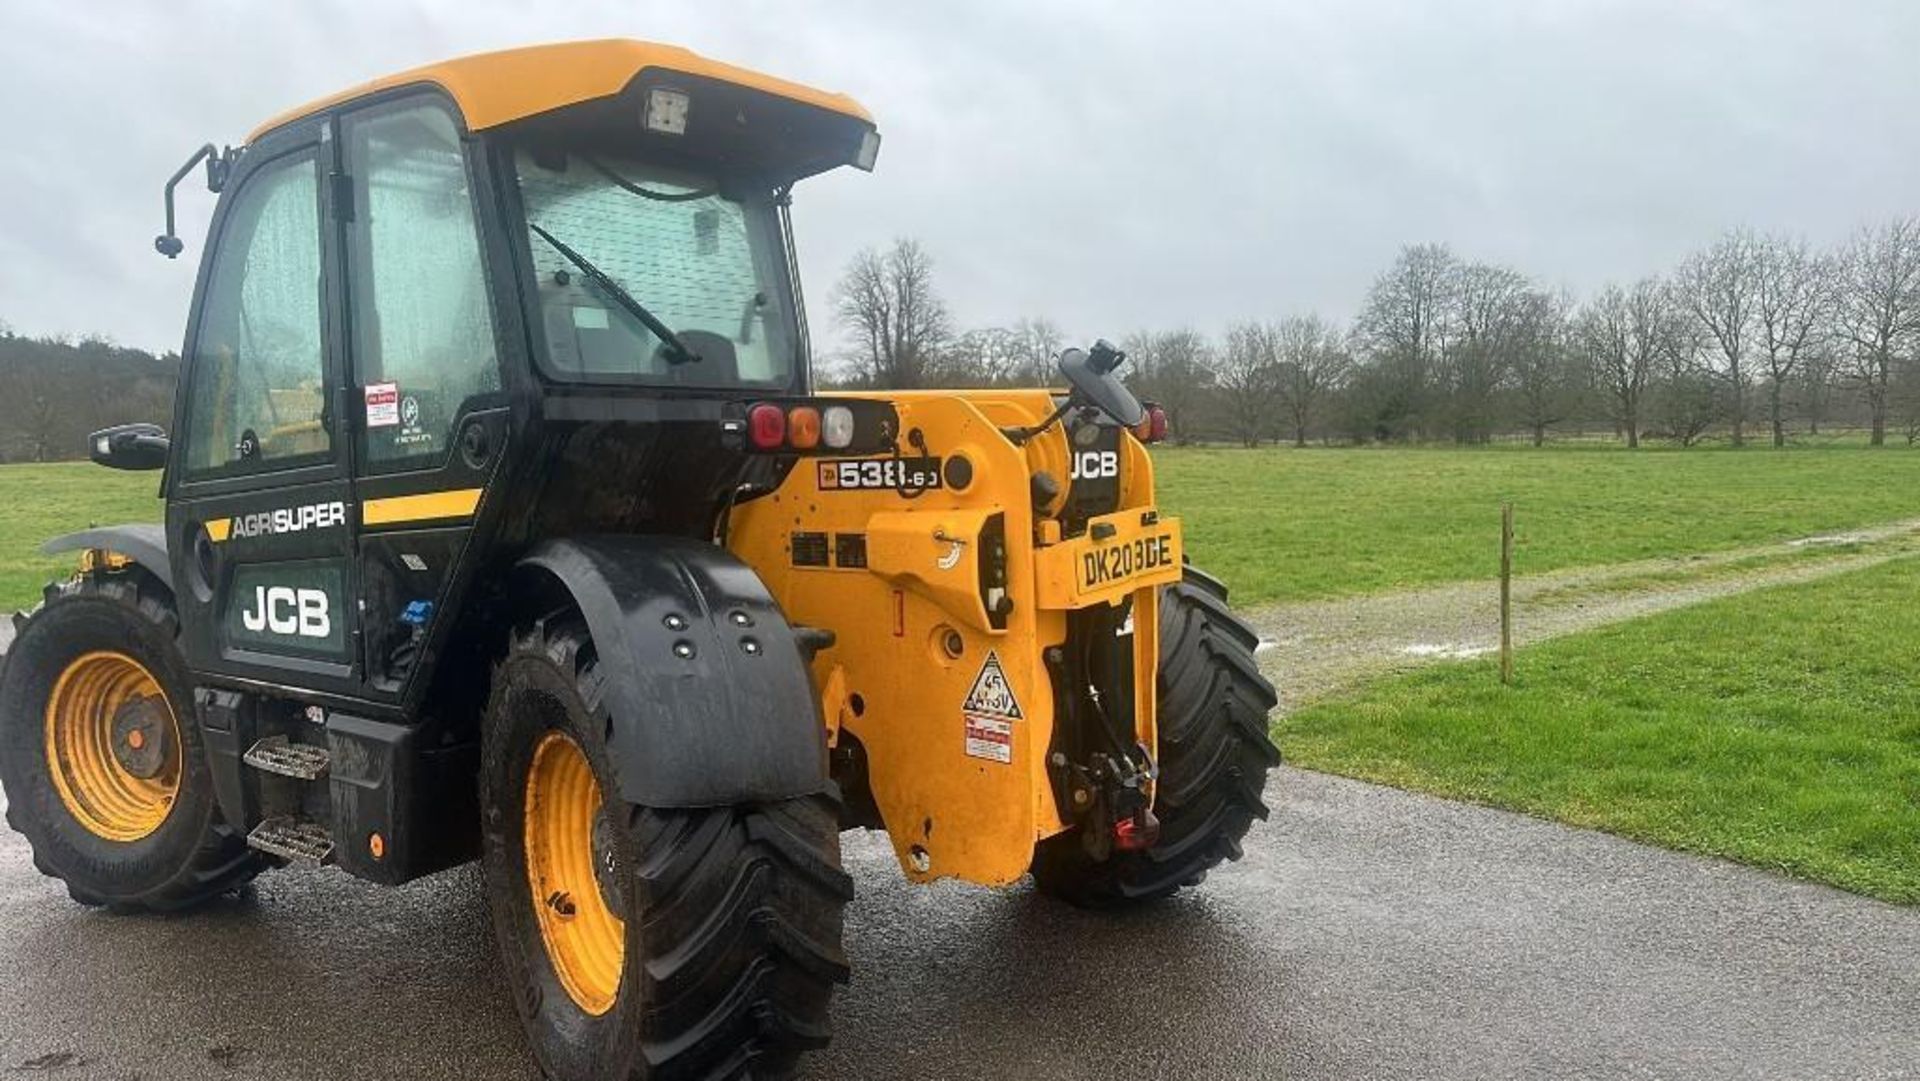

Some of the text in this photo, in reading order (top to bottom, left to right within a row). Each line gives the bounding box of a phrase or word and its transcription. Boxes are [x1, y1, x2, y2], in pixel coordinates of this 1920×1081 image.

[1070, 451, 1119, 480] JCB
[231, 501, 346, 540] AGRISUPER
[242, 586, 331, 638] JCB
